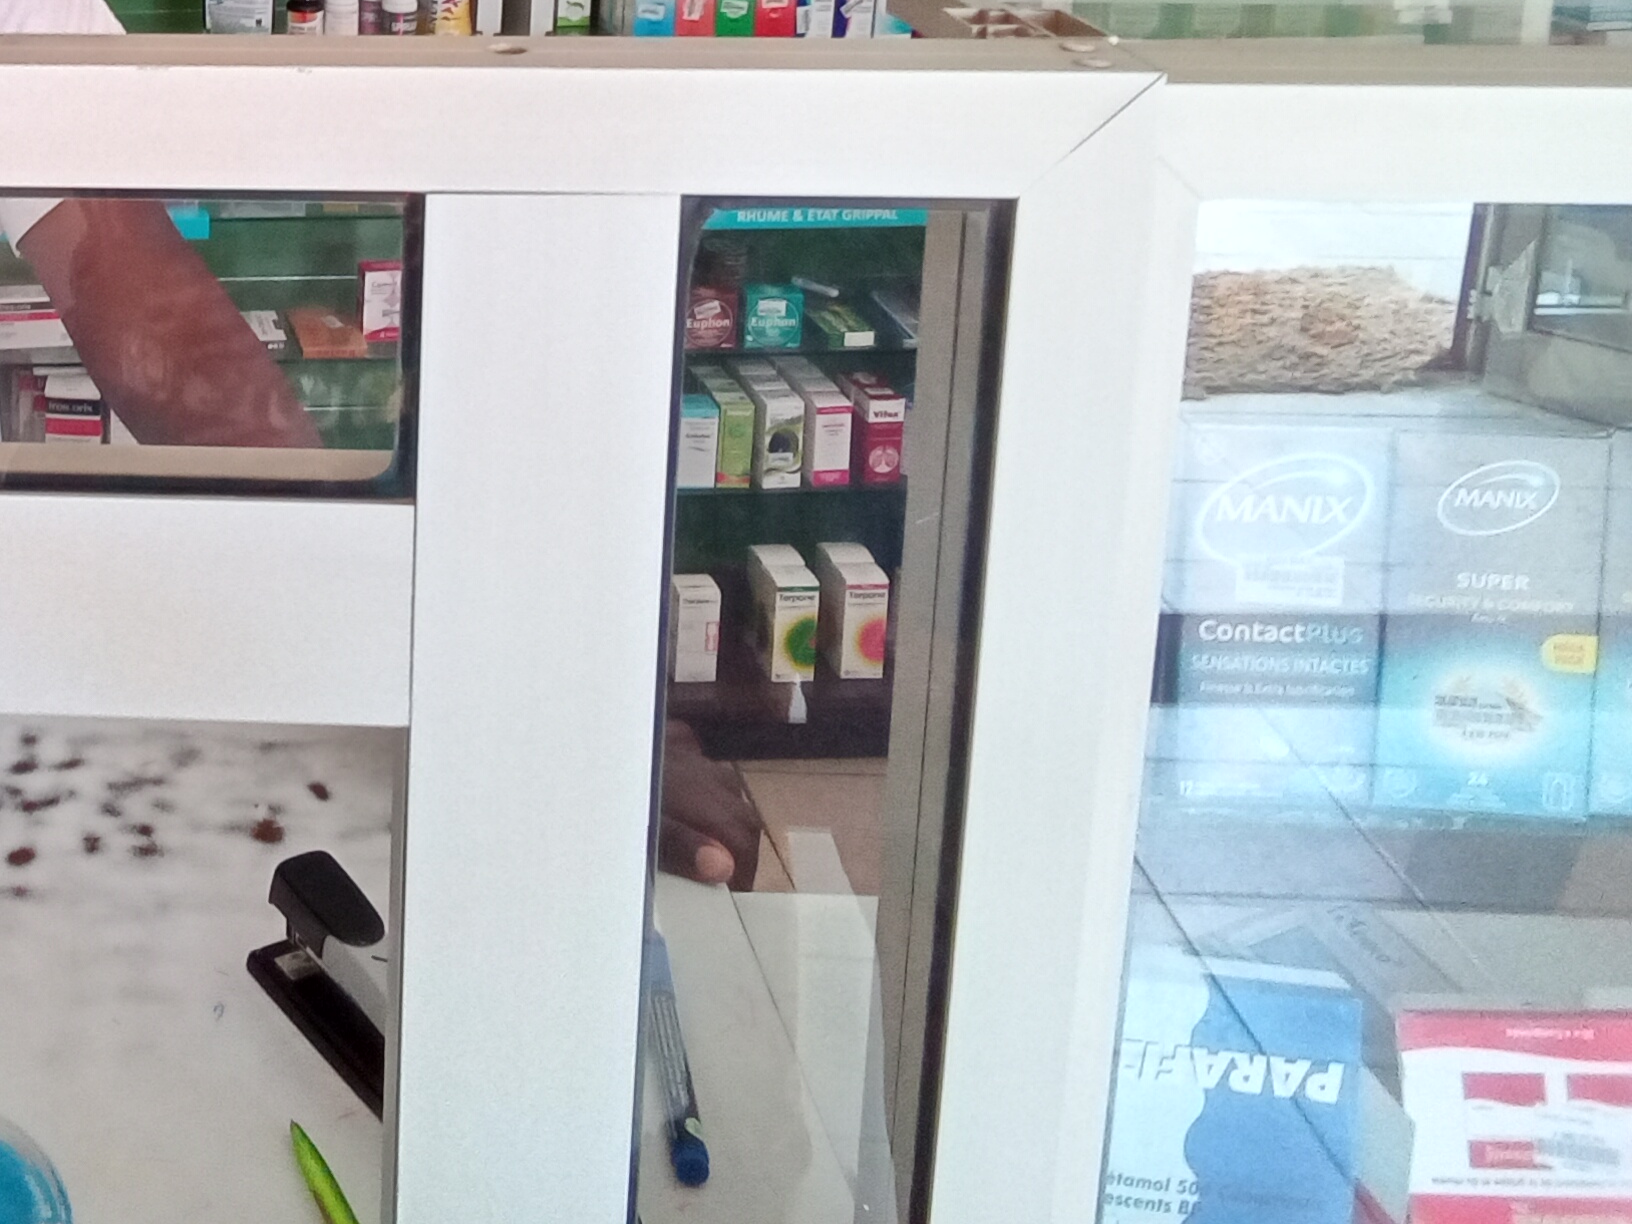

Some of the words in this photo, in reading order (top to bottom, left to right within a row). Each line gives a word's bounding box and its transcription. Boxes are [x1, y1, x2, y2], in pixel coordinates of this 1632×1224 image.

[737, 209, 789, 222] RHUME
[793, 209, 804, 222] &
[842, 208, 899, 221] GRIPPAL
[686, 317, 730, 329] Euphon
[751, 316, 796, 328] Euphon
[1215, 494, 1353, 524] MANIX
[1455, 488, 1539, 510] MANIX
[1456, 572, 1530, 592] SUPER
[1197, 618, 1364, 646] ContactPlus
[1190, 653, 1292, 675] SENSATIONS
[1294, 655, 1370, 677] INTACTES
